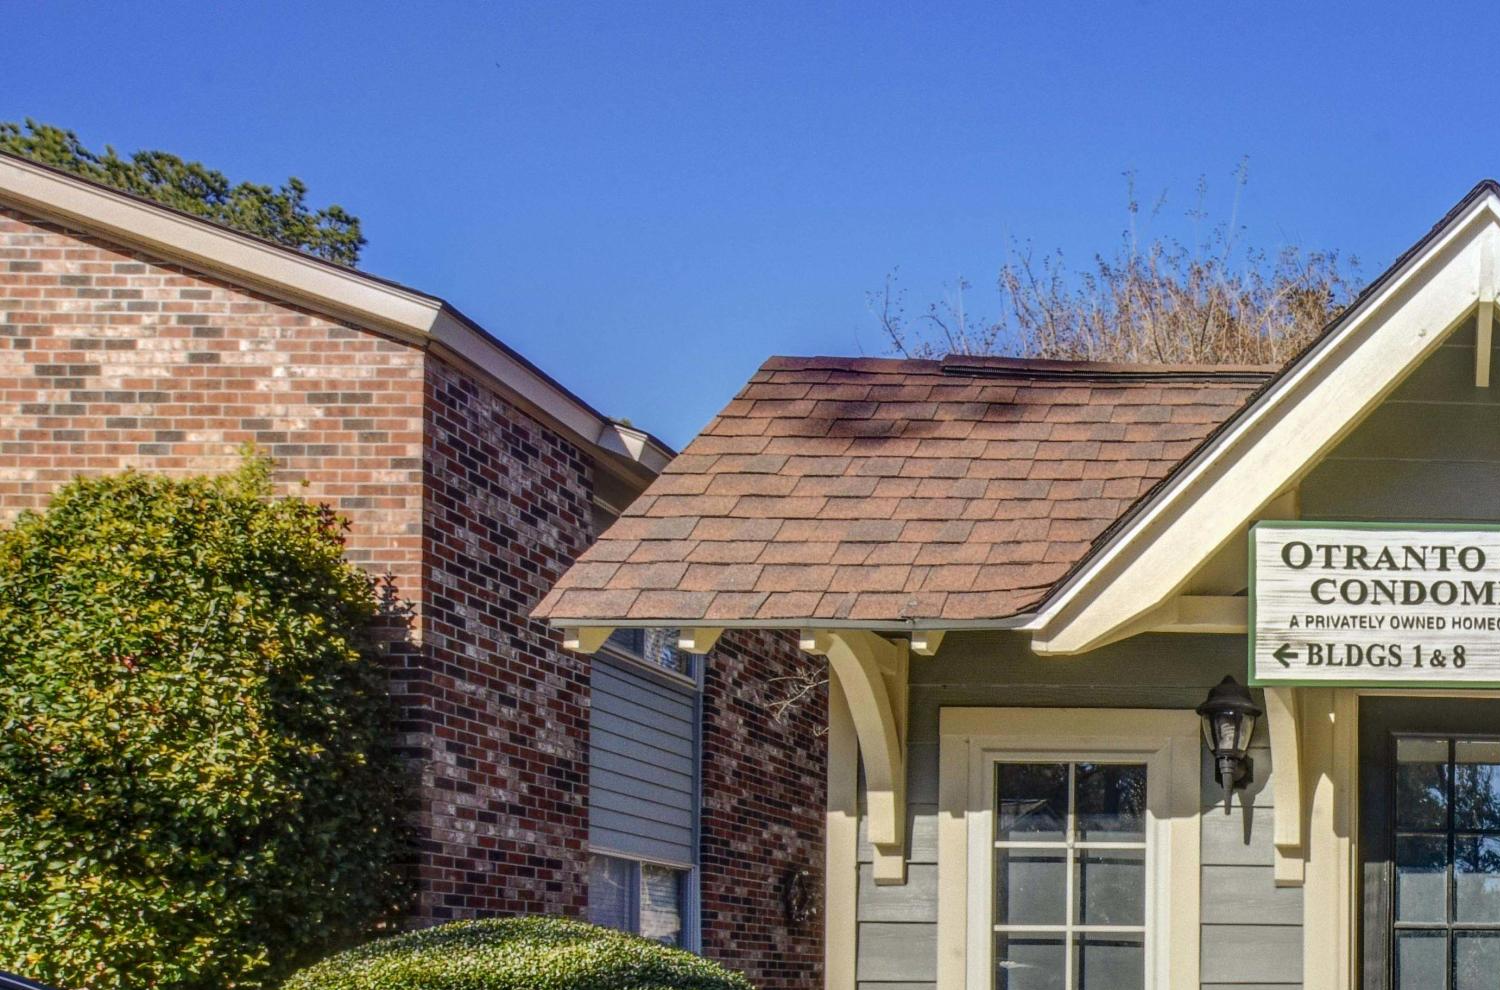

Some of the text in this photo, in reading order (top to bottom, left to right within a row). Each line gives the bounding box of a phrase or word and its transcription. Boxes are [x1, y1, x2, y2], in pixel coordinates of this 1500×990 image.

[1281, 541, 1487, 572] OTRANTO
[1289, 615, 1300, 629] A
[1305, 615, 1385, 630] PRIVATELY
[1390, 616, 1446, 630] OWNED
[1306, 643, 1402, 668] BLDGS
